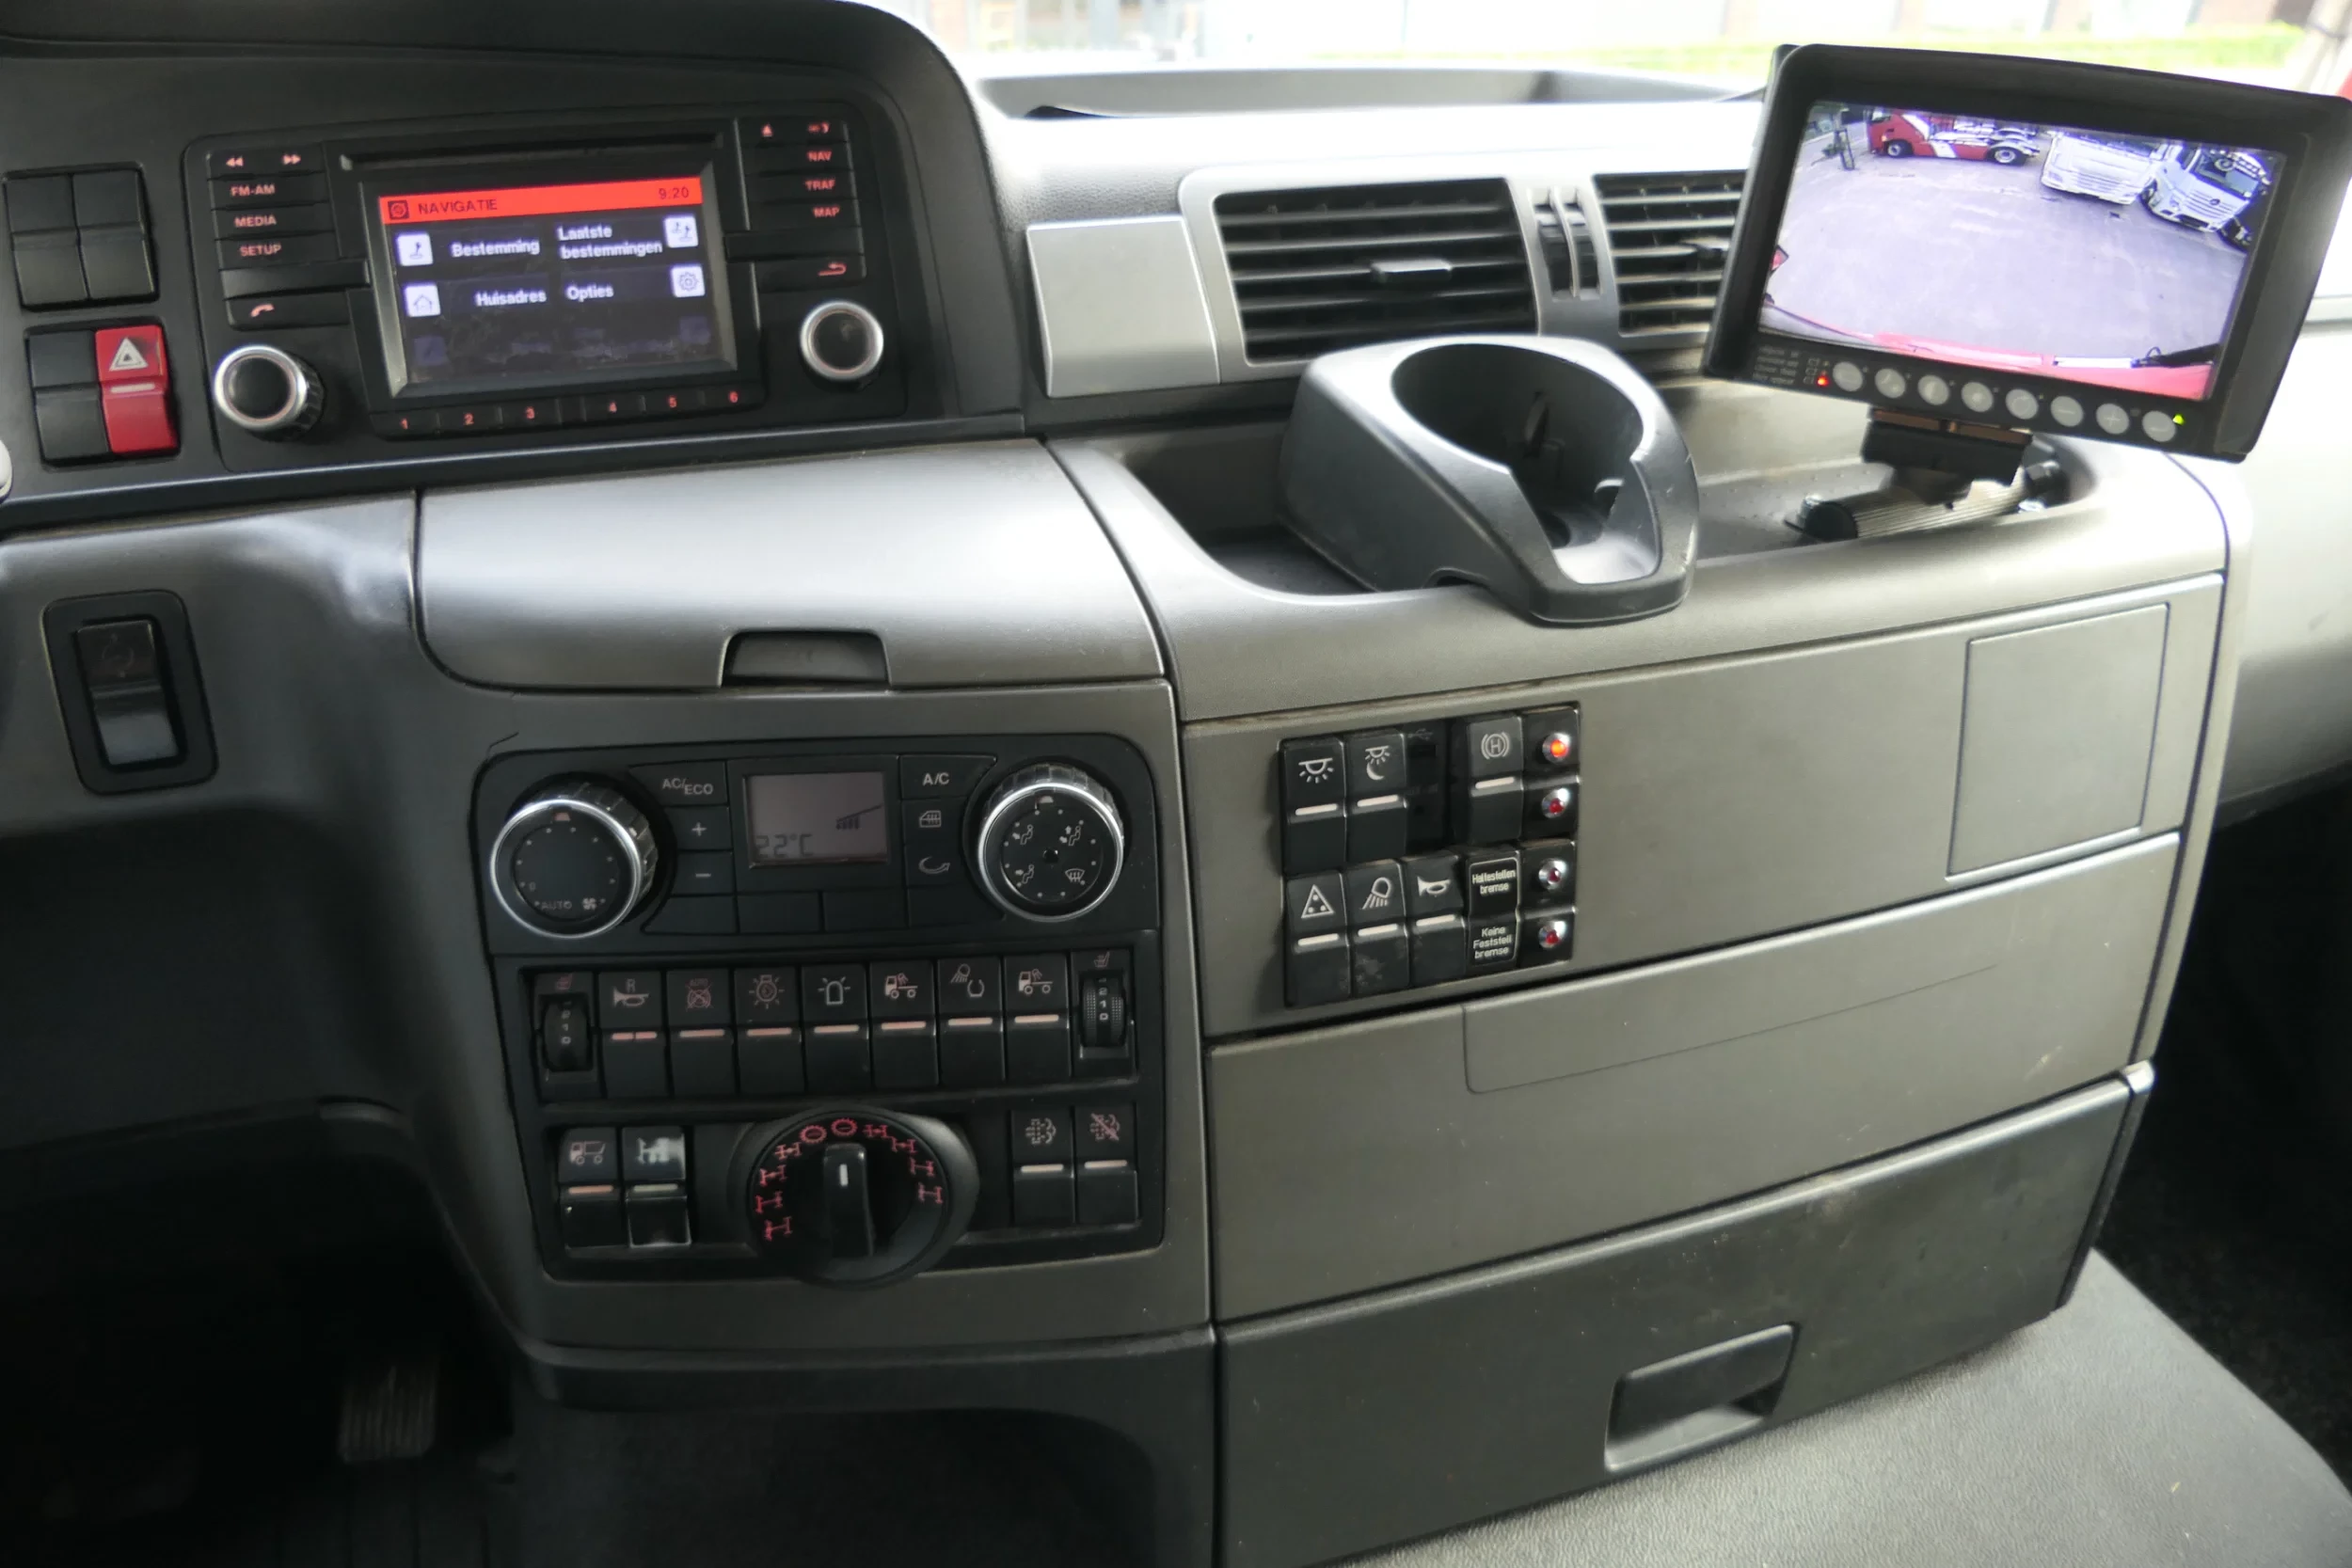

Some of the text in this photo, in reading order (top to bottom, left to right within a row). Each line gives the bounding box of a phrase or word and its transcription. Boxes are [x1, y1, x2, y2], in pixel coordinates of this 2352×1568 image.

[807, 150, 832, 161] NAV
[230, 183, 276, 197] FM-AM
[805, 179, 835, 190] TRAF
[418, 185, 691, 215] NAVIGATIE 9:20
[813, 206, 840, 217] MAP
[234, 214, 277, 228] MEDIA
[557, 224, 613, 242] Laatste
[239, 243, 282, 257] SETUP
[451, 237, 541, 259] Bestemming
[560, 240, 663, 261] bestemmingen
[474, 289, 547, 308] Huisadres
[567, 283, 614, 303] Opties
[401, 389, 739, 430] 1 2 3 4 5 6
[923, 772, 950, 786] A/C
[1472, 870, 1516, 884] Haltestellen
[1480, 882, 1510, 895] bremse
[541, 899, 573, 911] AUTO
[1481, 927, 1506, 938] Keine
[1473, 934, 1513, 950] Feststell
[1474, 946, 1509, 959] bremse
[626, 977, 636, 993] R
